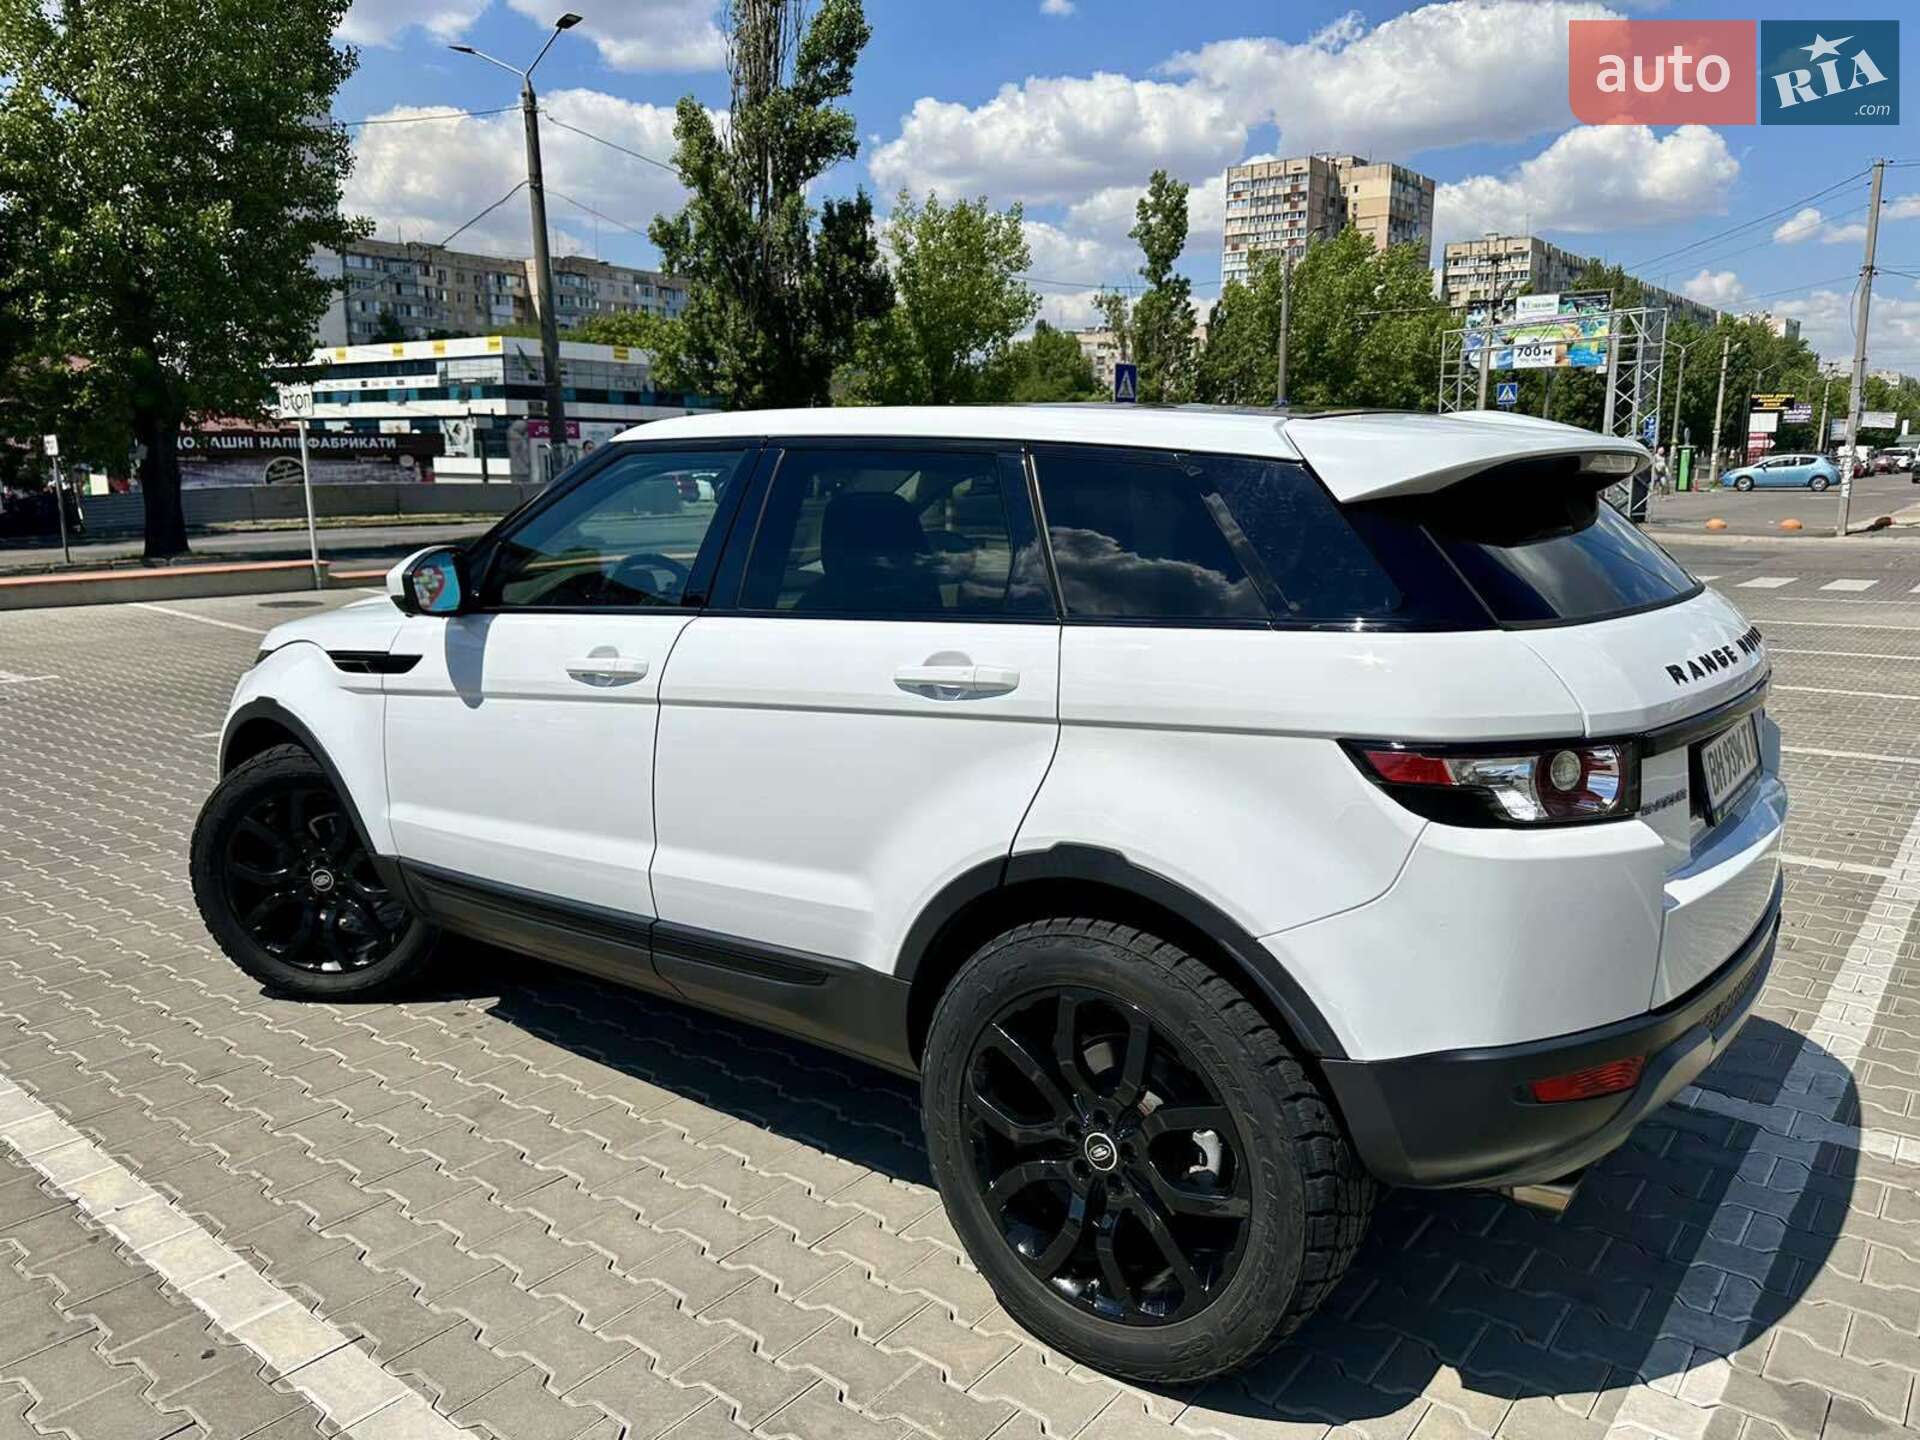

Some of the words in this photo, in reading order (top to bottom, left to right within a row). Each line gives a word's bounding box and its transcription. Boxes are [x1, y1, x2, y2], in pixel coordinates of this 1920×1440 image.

[1517, 346, 1541, 358] 700
[177, 436, 254, 450] ОАШНІ
[260, 436, 397, 449] НАПІФАБРИКАТИ
[1665, 644, 1738, 685] RANGE
